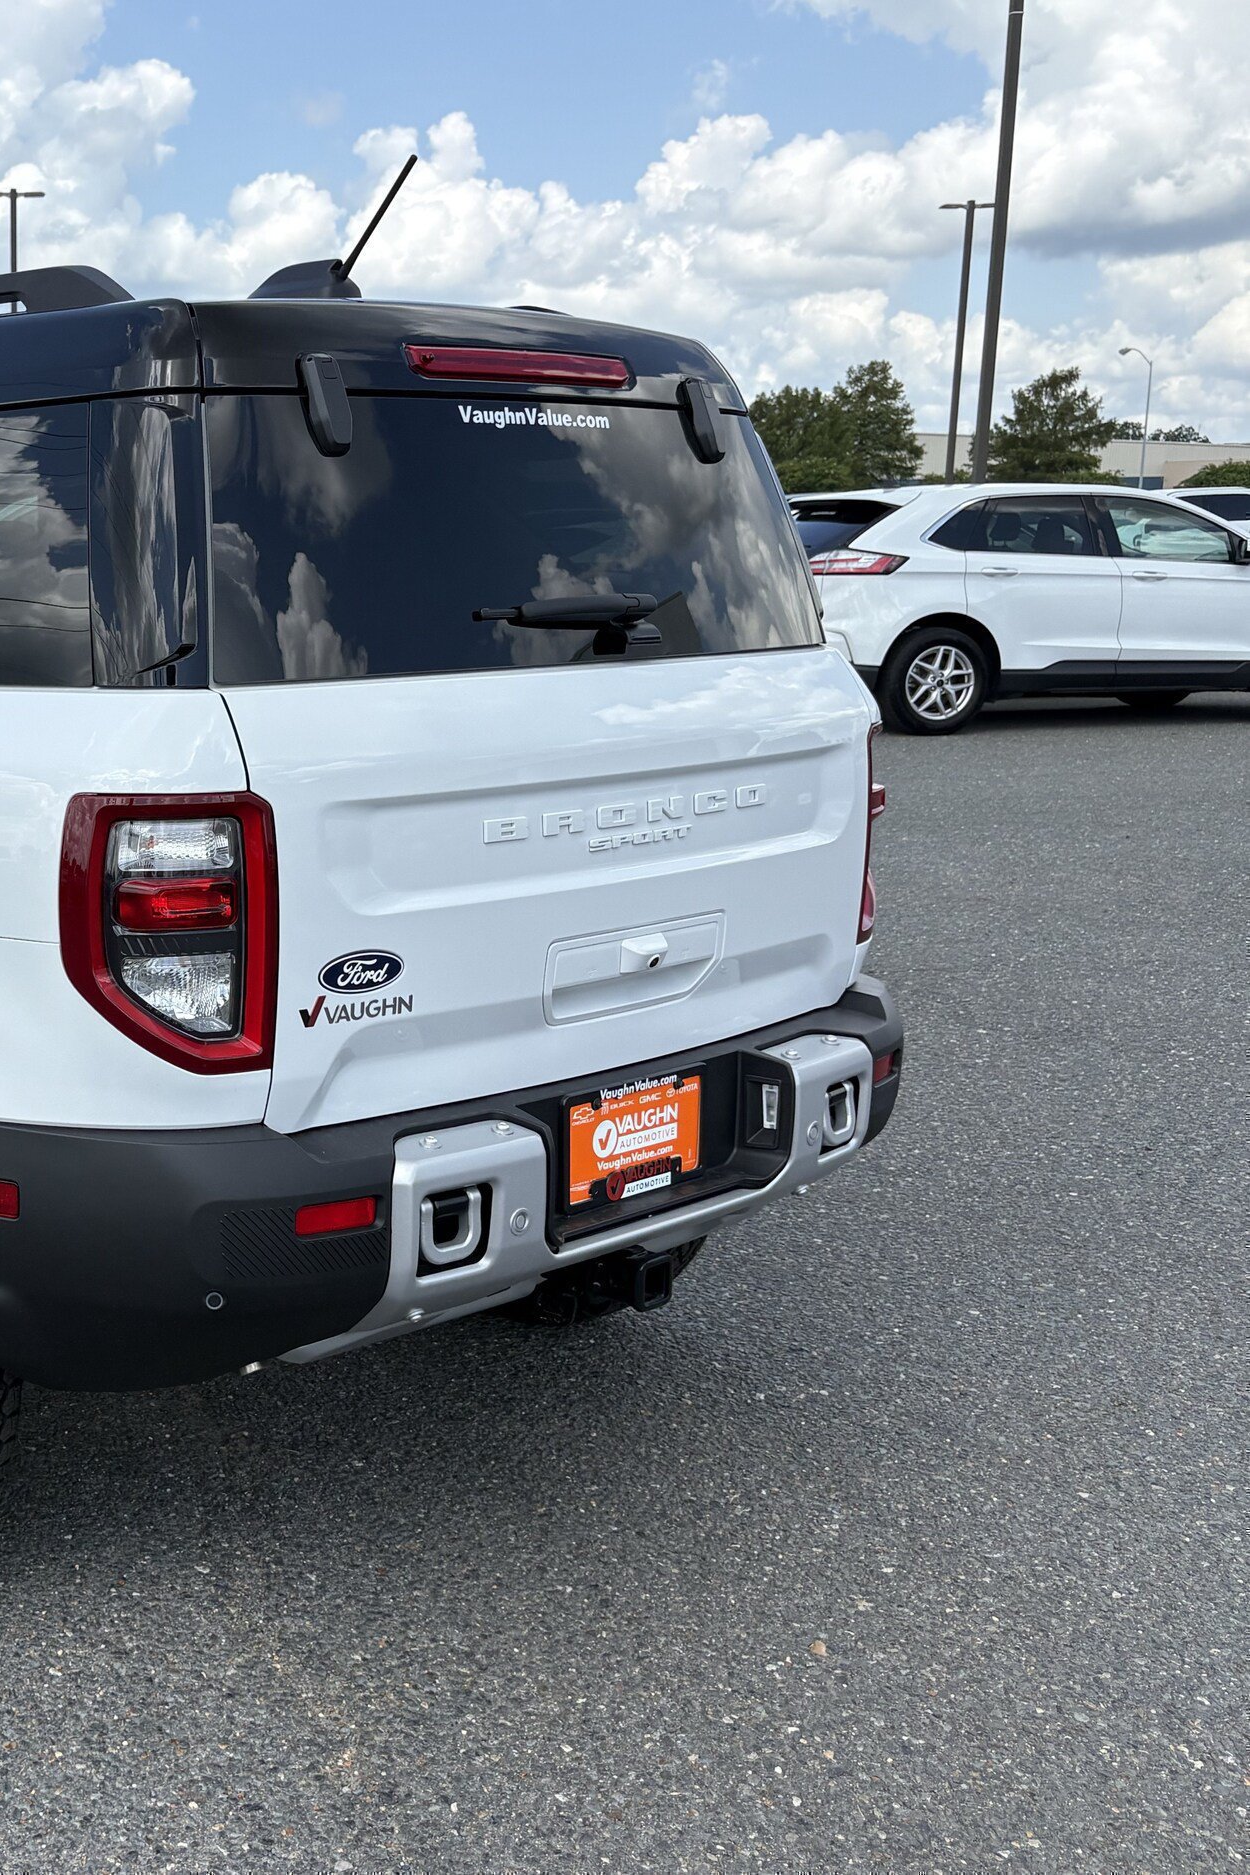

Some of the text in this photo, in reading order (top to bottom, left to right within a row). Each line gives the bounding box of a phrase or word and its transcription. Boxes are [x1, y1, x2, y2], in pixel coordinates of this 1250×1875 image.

[457, 405, 610, 429] VaughnValue.com
[483, 783, 767, 844] BRONCO
[589, 824, 693, 852] SPORT
[337, 958, 390, 987] Ford
[323, 994, 414, 1025] VAUGHN
[600, 1074, 678, 1100] VaughnValue.com
[639, 1092, 662, 1104] GMC
[609, 1100, 635, 1110] BUICK
[615, 1102, 679, 1134] VAUGHN
[619, 1126, 676, 1149] AUTOMOTIVE
[597, 1145, 673, 1171] VaughnValue.com
[621, 1156, 672, 1182] VAUGHN
[626, 1175, 670, 1194] AUTOMOTIVE
